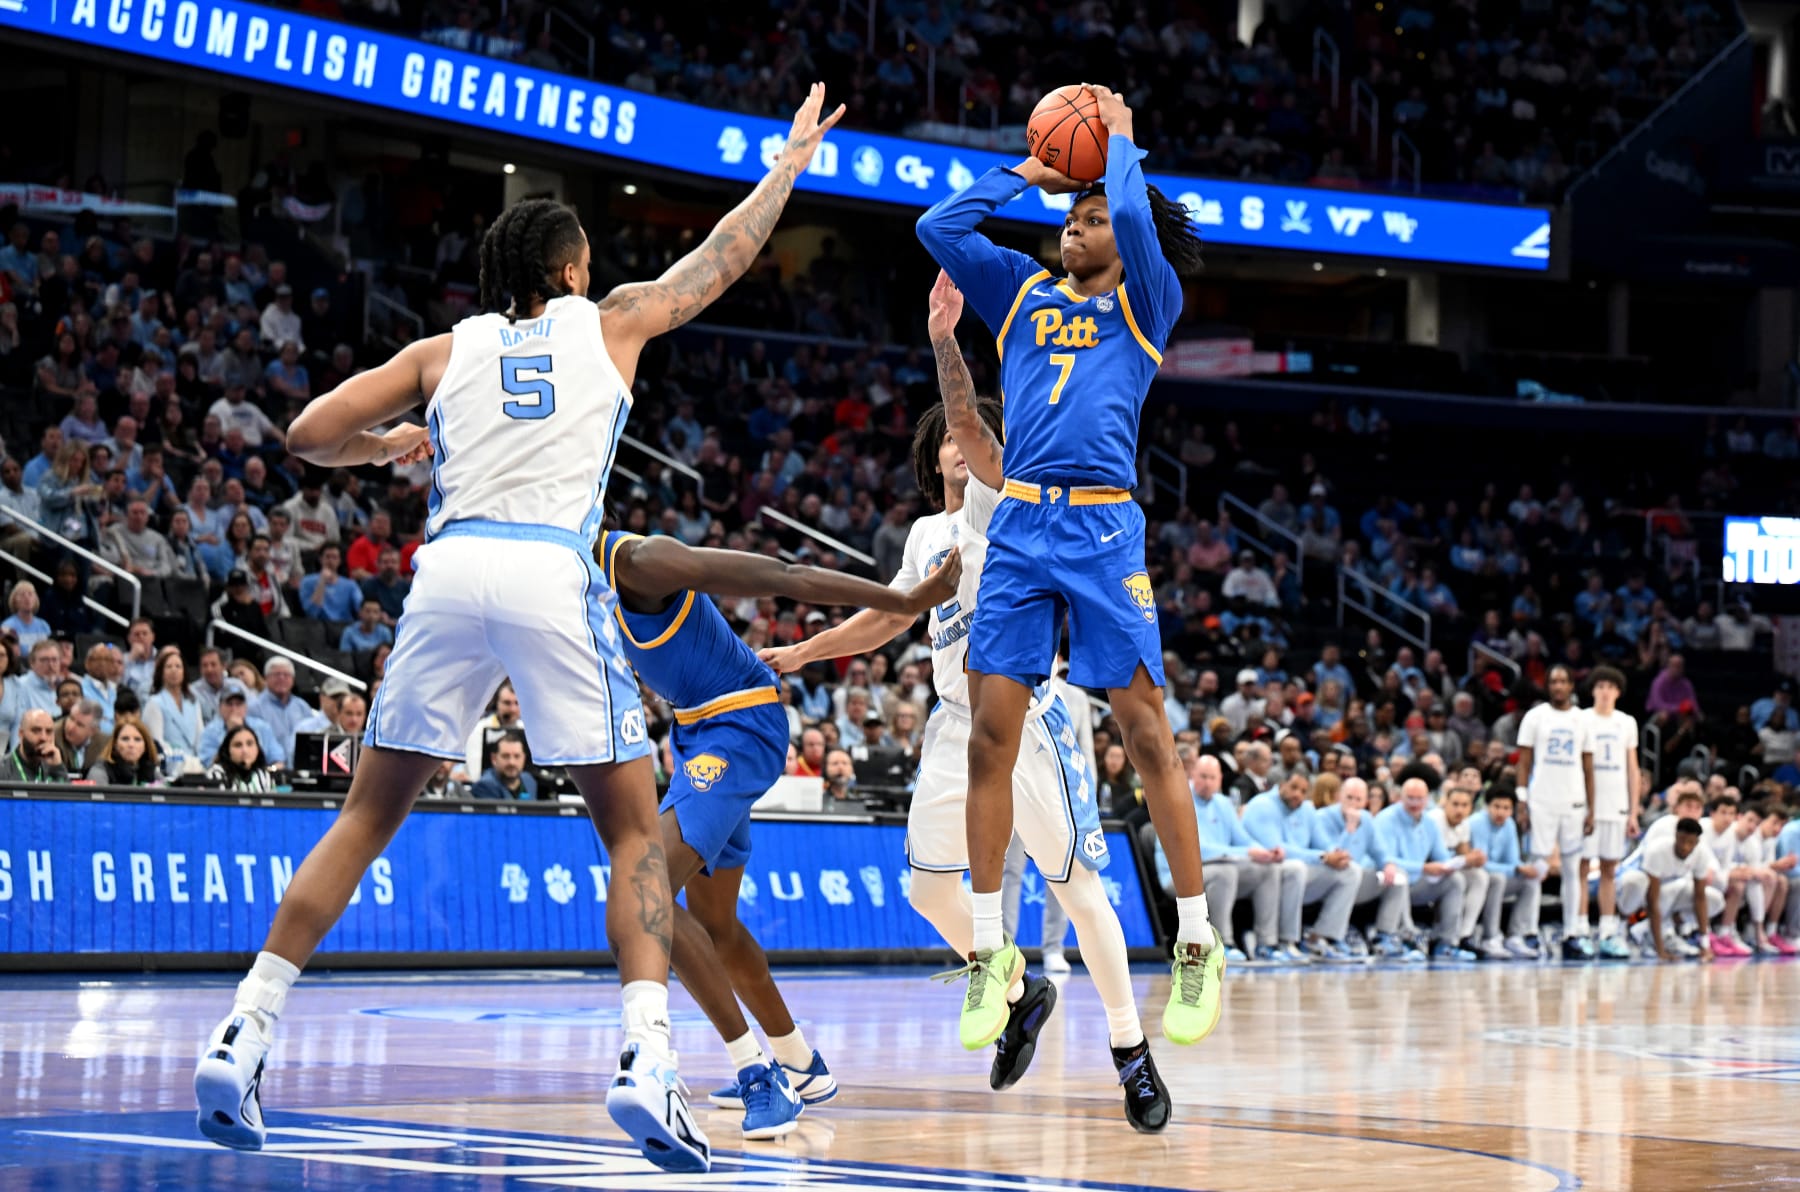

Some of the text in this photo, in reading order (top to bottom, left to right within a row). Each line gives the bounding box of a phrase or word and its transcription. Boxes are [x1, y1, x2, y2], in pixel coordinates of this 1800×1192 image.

[71, 0, 379, 88] ACCOMPLISH
[401, 52, 638, 145] GREATNESS
[1240, 195, 1265, 231] S
[1326, 205, 1373, 237] VT
[1029, 308, 1101, 349] Pitt
[499, 354, 556, 420] 5
[1047, 353, 1077, 405] 7
[1046, 486, 1063, 505] P
[1546, 737, 1575, 756] 24
[92, 851, 395, 906] GREATNS
[767, 870, 805, 902] U
